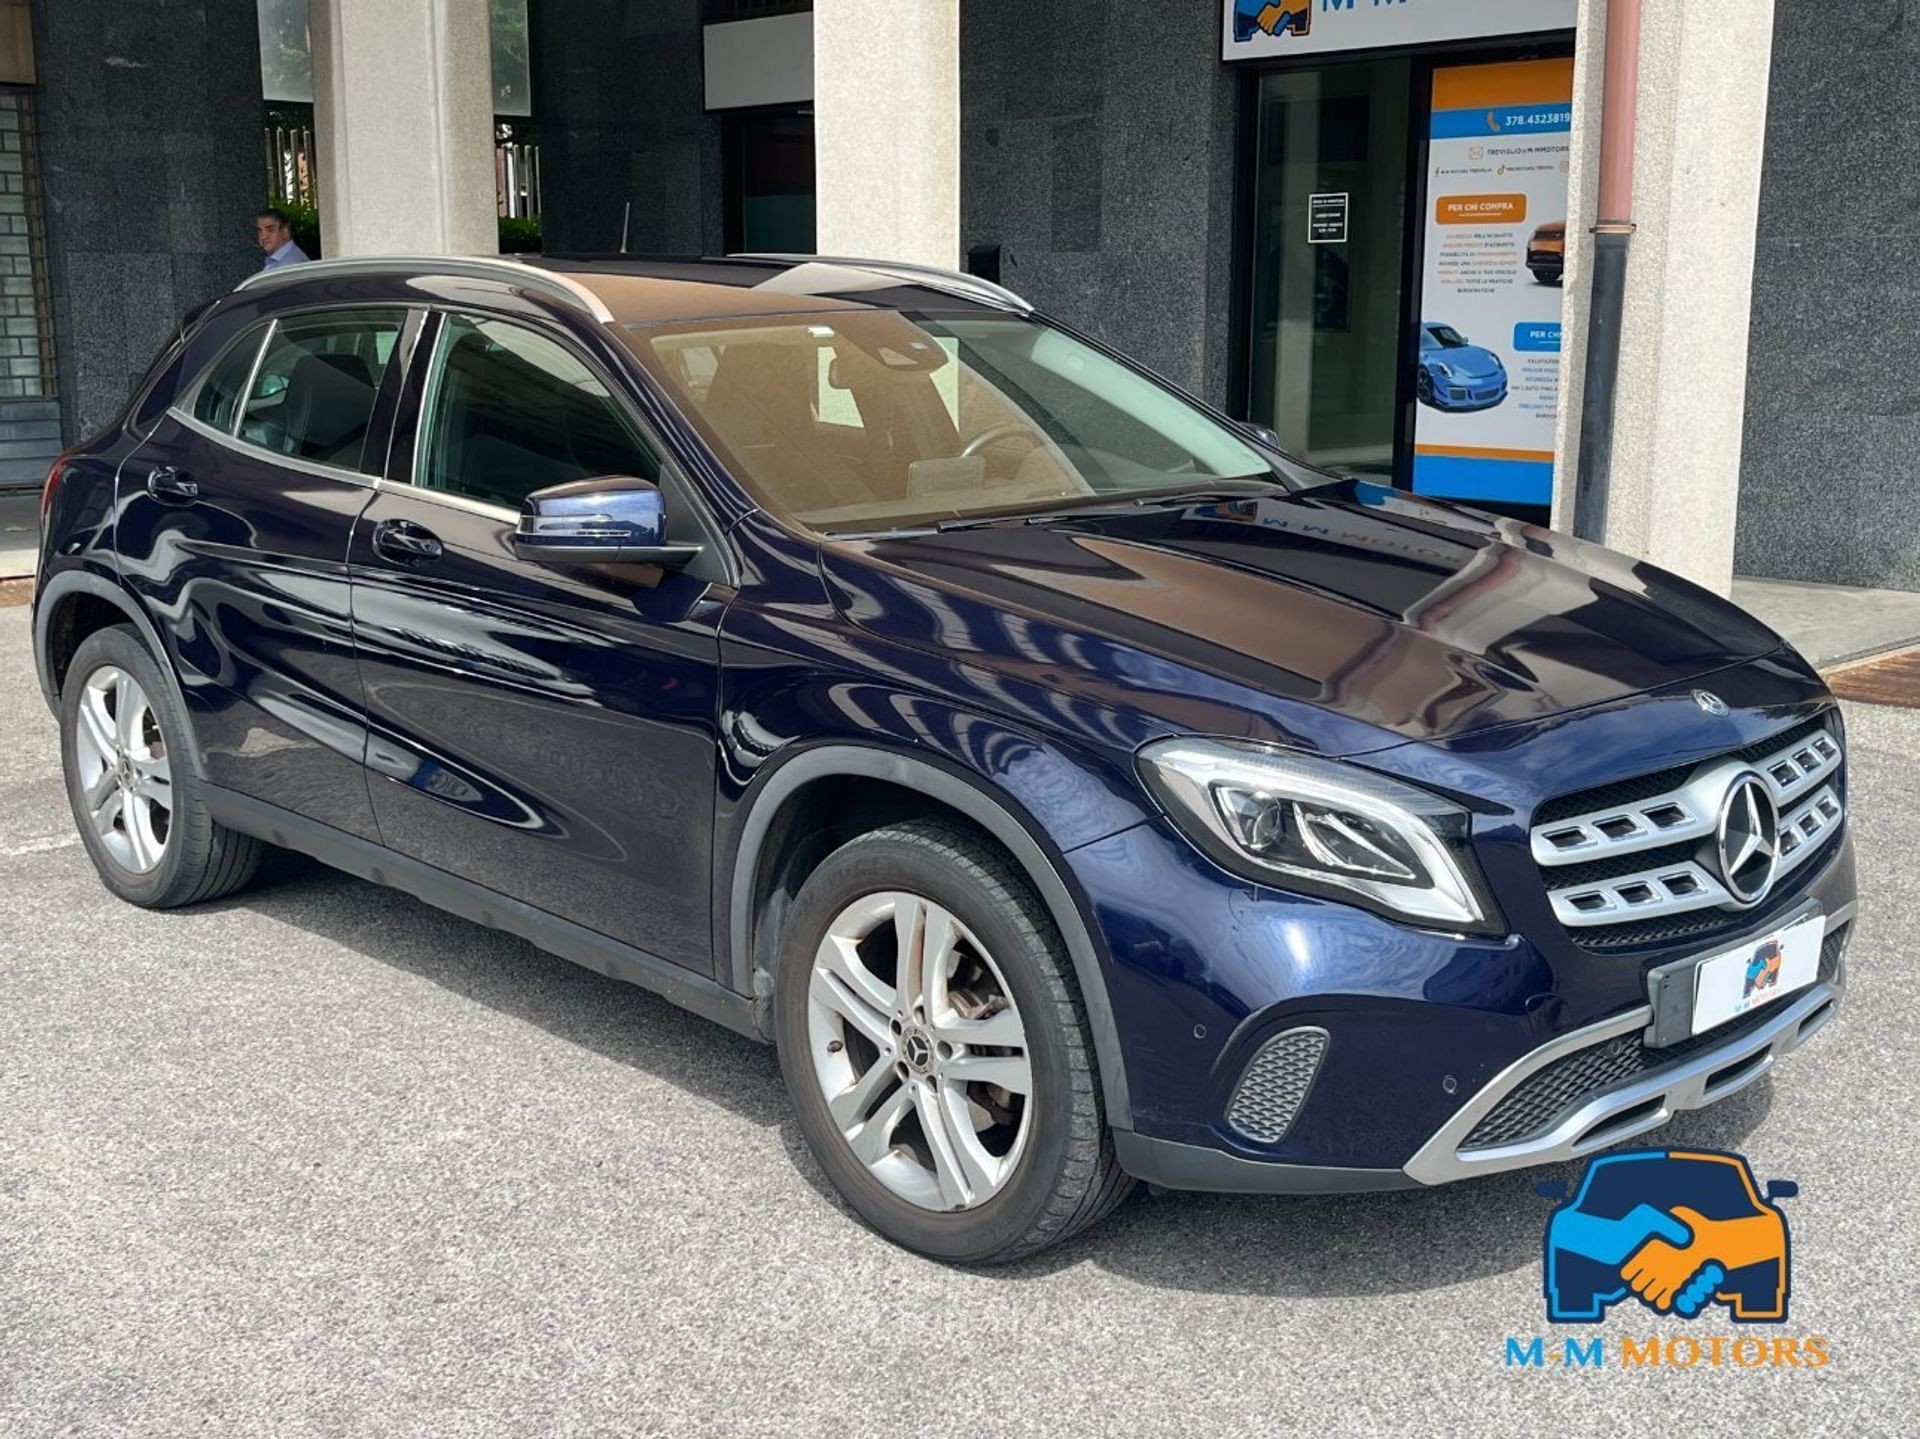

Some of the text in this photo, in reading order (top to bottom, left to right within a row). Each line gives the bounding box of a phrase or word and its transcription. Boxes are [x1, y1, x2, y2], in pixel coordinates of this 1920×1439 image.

[1448, 202, 1514, 211] PER CHI COMPRA
[1530, 330, 1546, 338] PER
